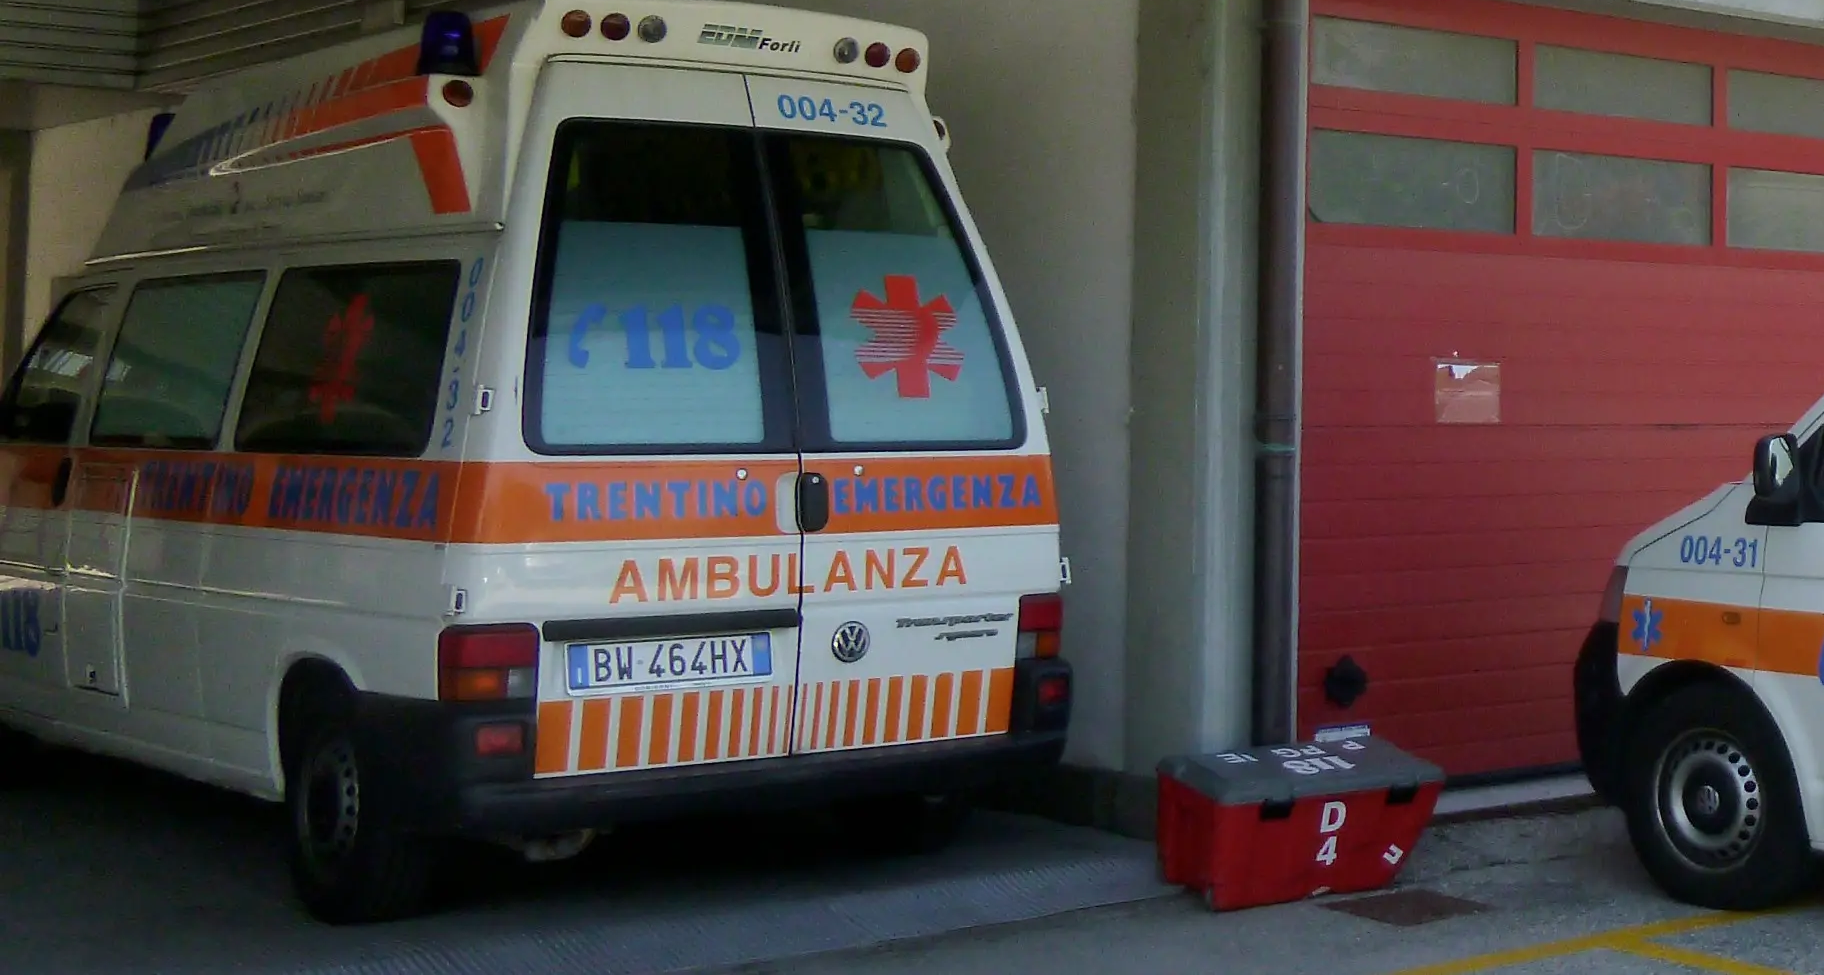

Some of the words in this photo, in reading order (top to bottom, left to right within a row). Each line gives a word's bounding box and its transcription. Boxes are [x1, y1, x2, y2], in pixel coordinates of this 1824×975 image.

[777, 94, 887, 128] 004-32
[617, 304, 742, 370] 118
[269, 462, 441, 533] EMERGENZA
[544, 479, 767, 522] TRENTINO
[834, 474, 1042, 513] EMERGENZA
[609, 544, 968, 604] AMBULANZA
[1680, 535, 1759, 569] 004-31
[593, 645, 633, 683] BW
[648, 637, 749, 678] 464HX
[1319, 800, 1347, 834] D
[1315, 836, 1338, 866] 4
